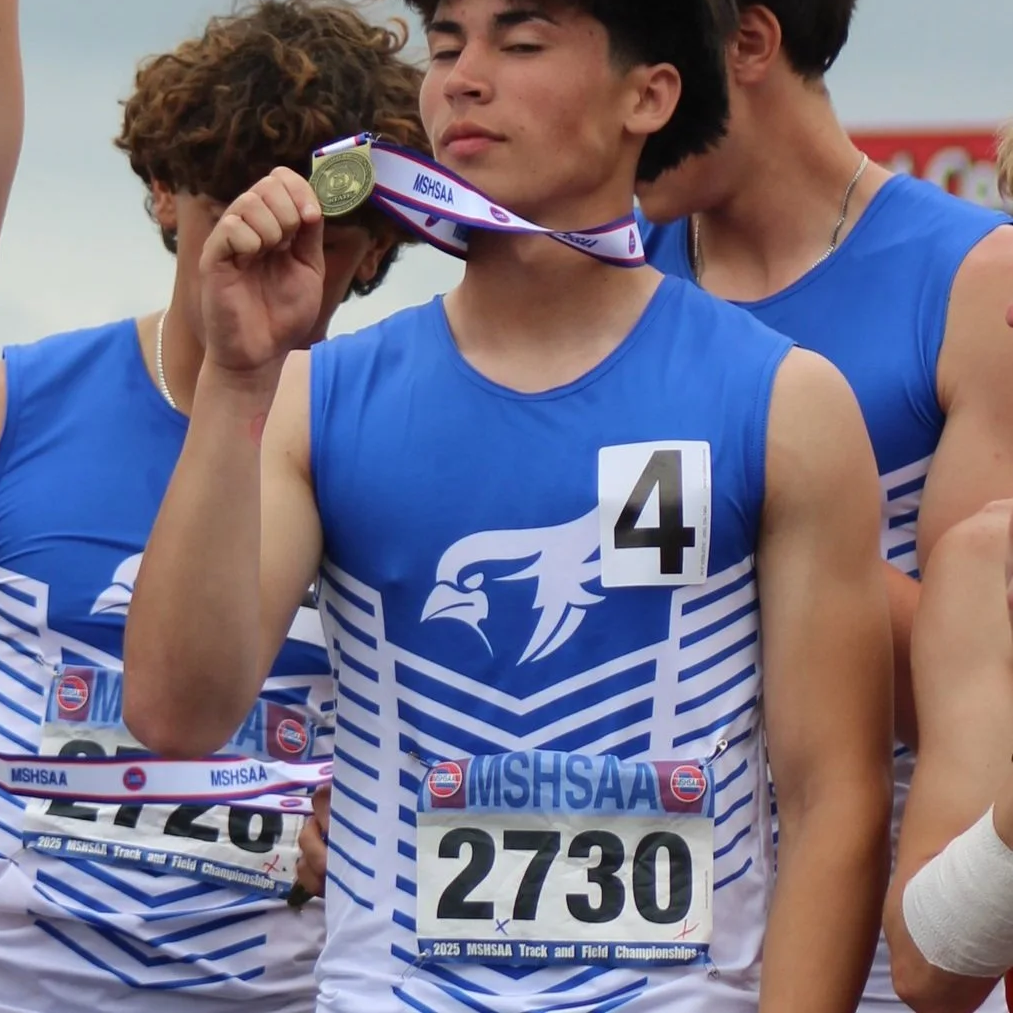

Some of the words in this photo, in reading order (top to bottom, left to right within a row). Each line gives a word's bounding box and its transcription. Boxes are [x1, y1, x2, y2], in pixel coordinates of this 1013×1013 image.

[412, 173, 454, 205] MSHSAA
[614, 449, 696, 575] 4
[11, 766, 68, 788] MSHSAA
[210, 765, 268, 787] MSHSAA
[469, 751, 659, 811] MSHSAA
[37, 835, 62, 849] 2025
[66, 839, 108, 856] MSHSAA
[113, 845, 141, 861] Track
[147, 852, 167, 865] and
[171, 855, 197, 872] Field
[201, 862, 276, 890] Championships
[437, 827, 693, 925] 2730
[433, 942, 460, 956] 2025
[466, 943, 513, 957] MSHSAA
[519, 944, 548, 958] Track
[554, 945, 575, 958] and
[581, 945, 608, 959] Field
[615, 945, 698, 961] Championships
